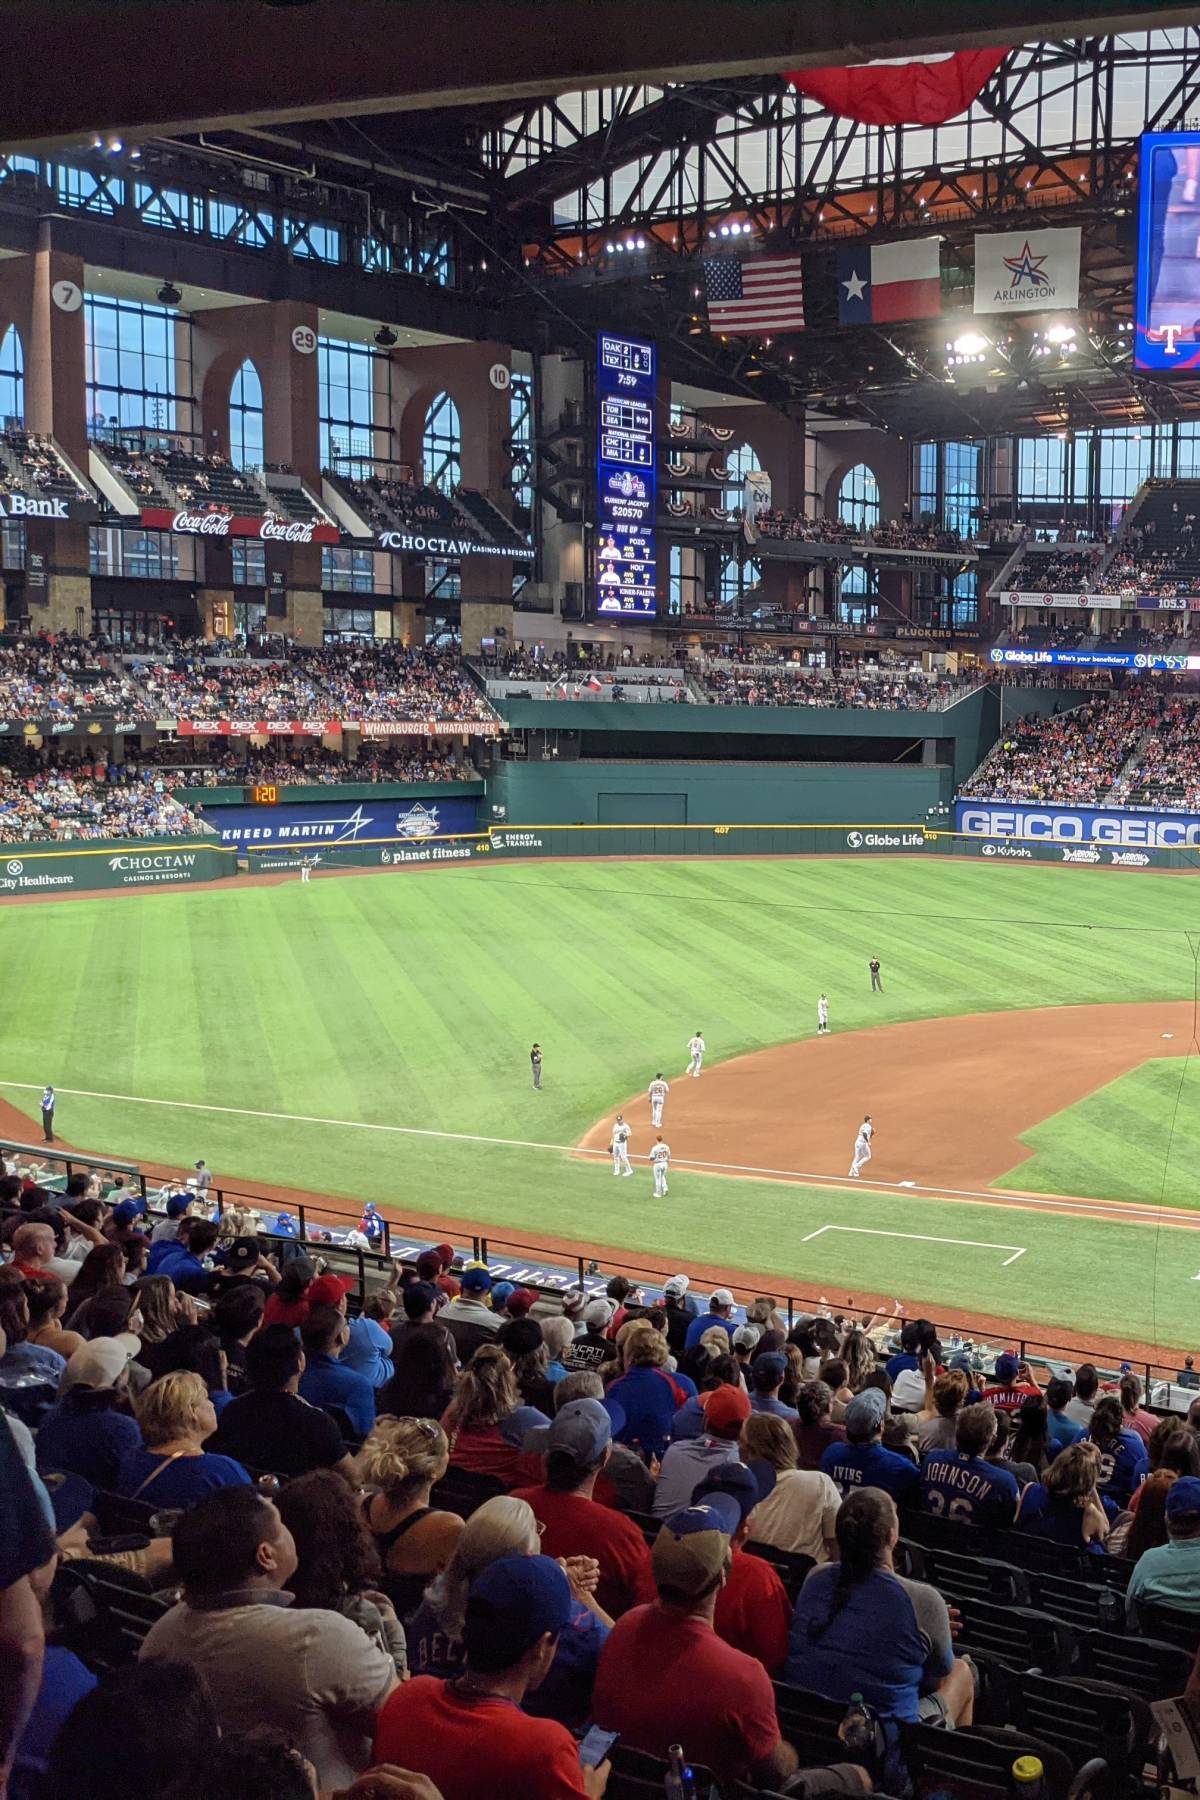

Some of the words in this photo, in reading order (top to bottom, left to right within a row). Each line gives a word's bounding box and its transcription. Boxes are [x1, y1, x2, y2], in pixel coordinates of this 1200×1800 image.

[62, 287, 73, 304] 7
[993, 287, 1056, 301] ARLINGTON
[295, 331, 315, 349] 29
[1159, 325, 1182, 354] T
[604, 342, 621, 353] OAK
[623, 346, 629, 355] 2
[605, 355, 620, 365] TEX
[492, 367, 507, 385] 10
[618, 373, 638, 386] 7:59
[606, 405, 620, 413] TOR
[10, 495, 69, 519] Bank
[612, 506, 643, 519] $20570
[173, 511, 233, 536] Coca-Cola
[260, 519, 315, 543] Coca-Cola
[389, 532, 472, 555] CHOCTAW
[472, 545, 500, 555] CASINOS
[1158, 599, 1187, 609] 105.3
[897, 627, 951, 638] PLUCKERS
[1005, 651, 1032, 662] Globe
[1034, 651, 1052, 663] Life
[1057, 654, 1076, 662] Who's
[1076, 656, 1091, 664] your
[1092, 655, 1130, 665] beneficiary?
[193, 721, 220, 730] DEX
[230, 721, 256, 730] DEX
[267, 721, 293, 730] DEX
[302, 721, 328, 730] DEX
[364, 721, 428, 735] WHATABURGER
[434, 721, 496, 735] WHATABURGER
[255, 786, 276, 802] 1:20
[961, 810, 1083, 841] GEICO
[222, 829, 272, 840] KHEED
[278, 825, 335, 838] MARTIN
[506, 840, 542, 848] TRANSFER
[865, 833, 900, 846] Globe
[903, 833, 924, 846] Life
[476, 844, 489, 852] 410
[998, 846, 1032, 858] Kubota
[1071, 849, 1097, 858] ARROW
[393, 849, 431, 864] planet
[433, 847, 471, 860] fitness
[1119, 852, 1146, 861] ARROW
[118, 855, 196, 870] CHOCTAW
[19, 874, 74, 887] Healthcare
[124, 874, 154, 882] CASINOS
[927, 1461, 992, 1501] JOHNSON
